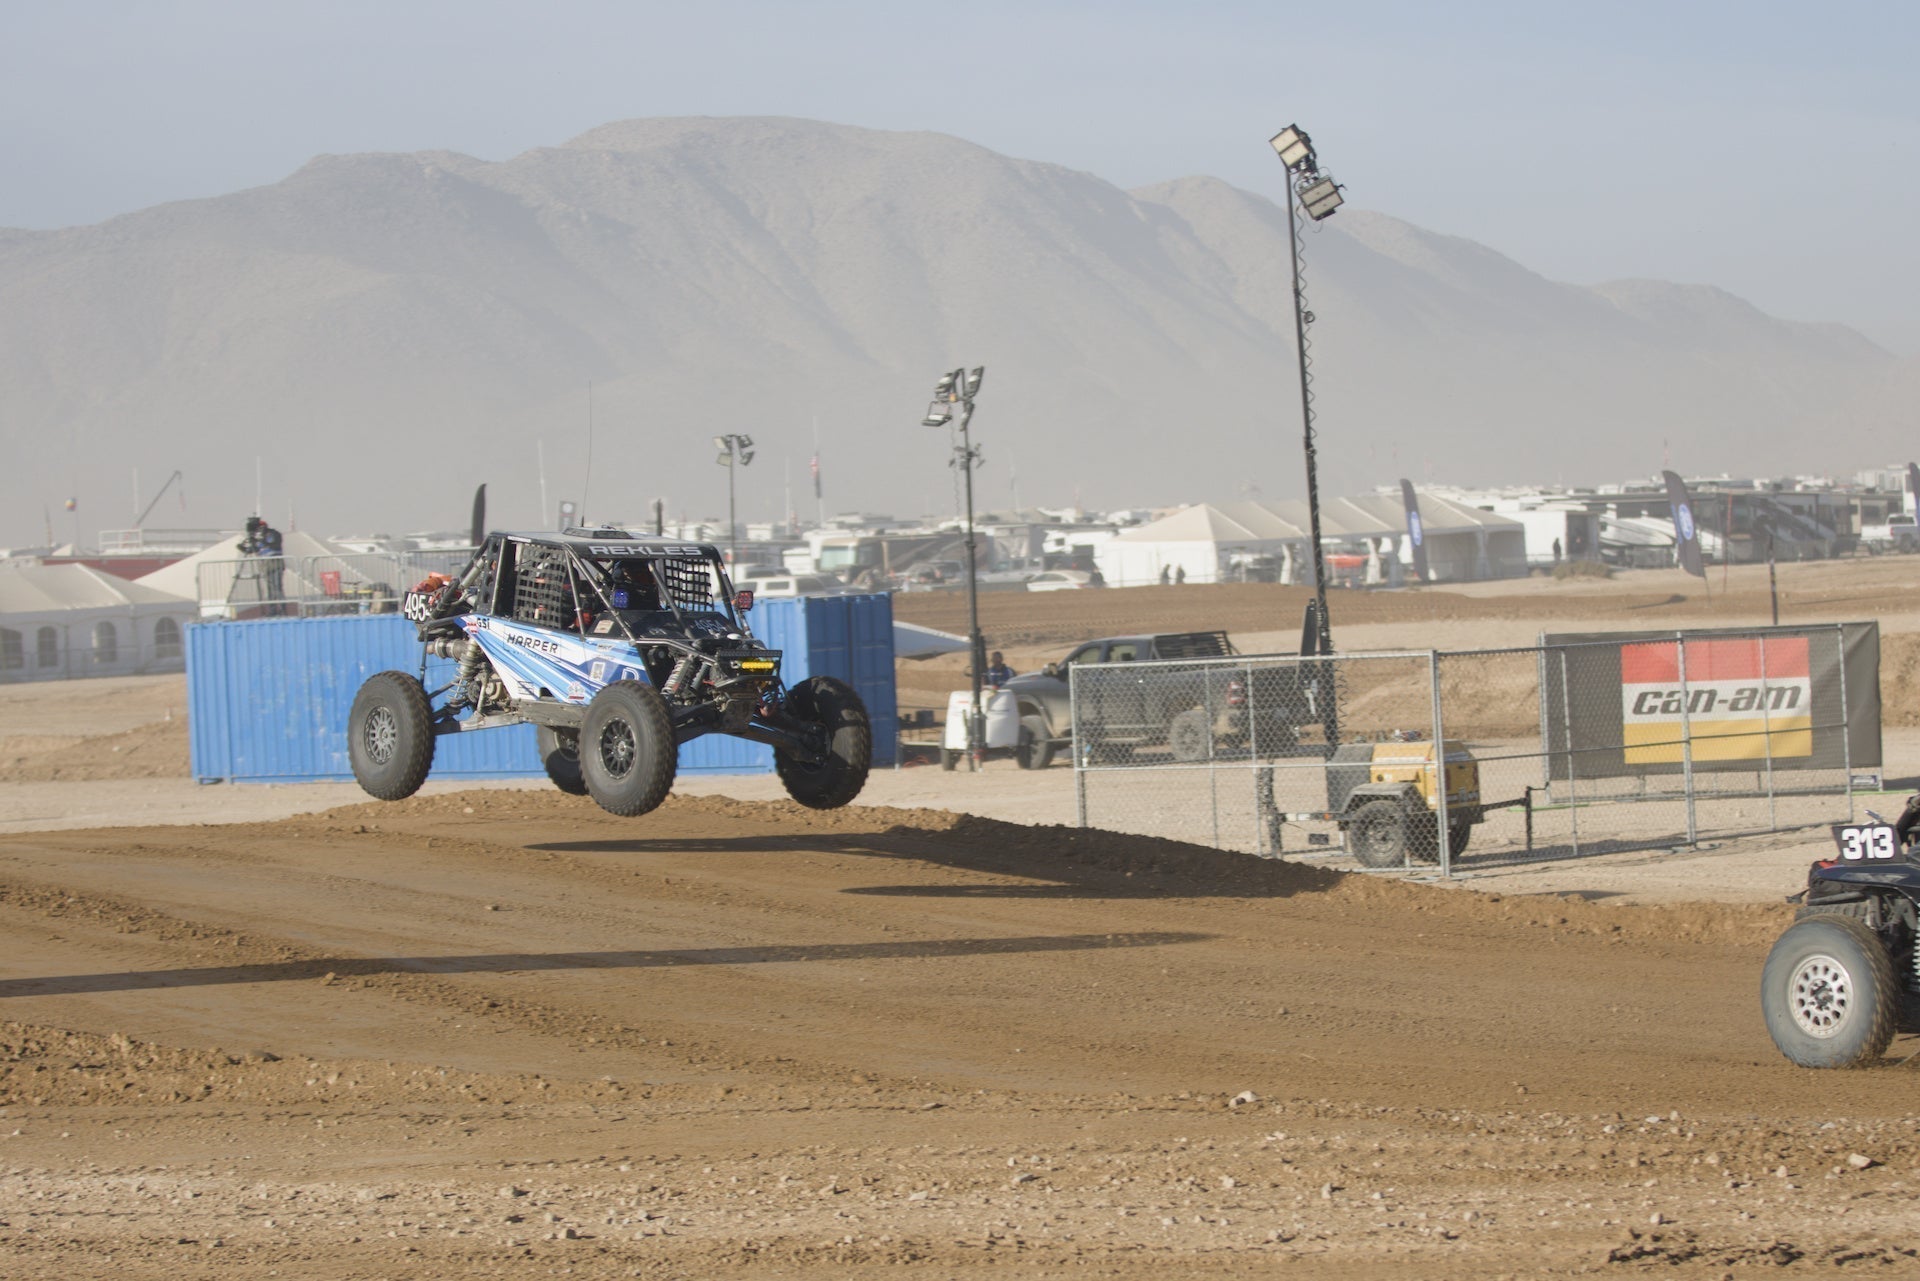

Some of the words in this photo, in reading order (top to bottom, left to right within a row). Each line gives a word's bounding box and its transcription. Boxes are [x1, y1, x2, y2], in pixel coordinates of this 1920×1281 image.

[588, 545, 702, 556] REKLES
[506, 633, 558, 654] HARPER
[1632, 685, 1802, 716] can-am
[1841, 826, 1894, 860] 313
